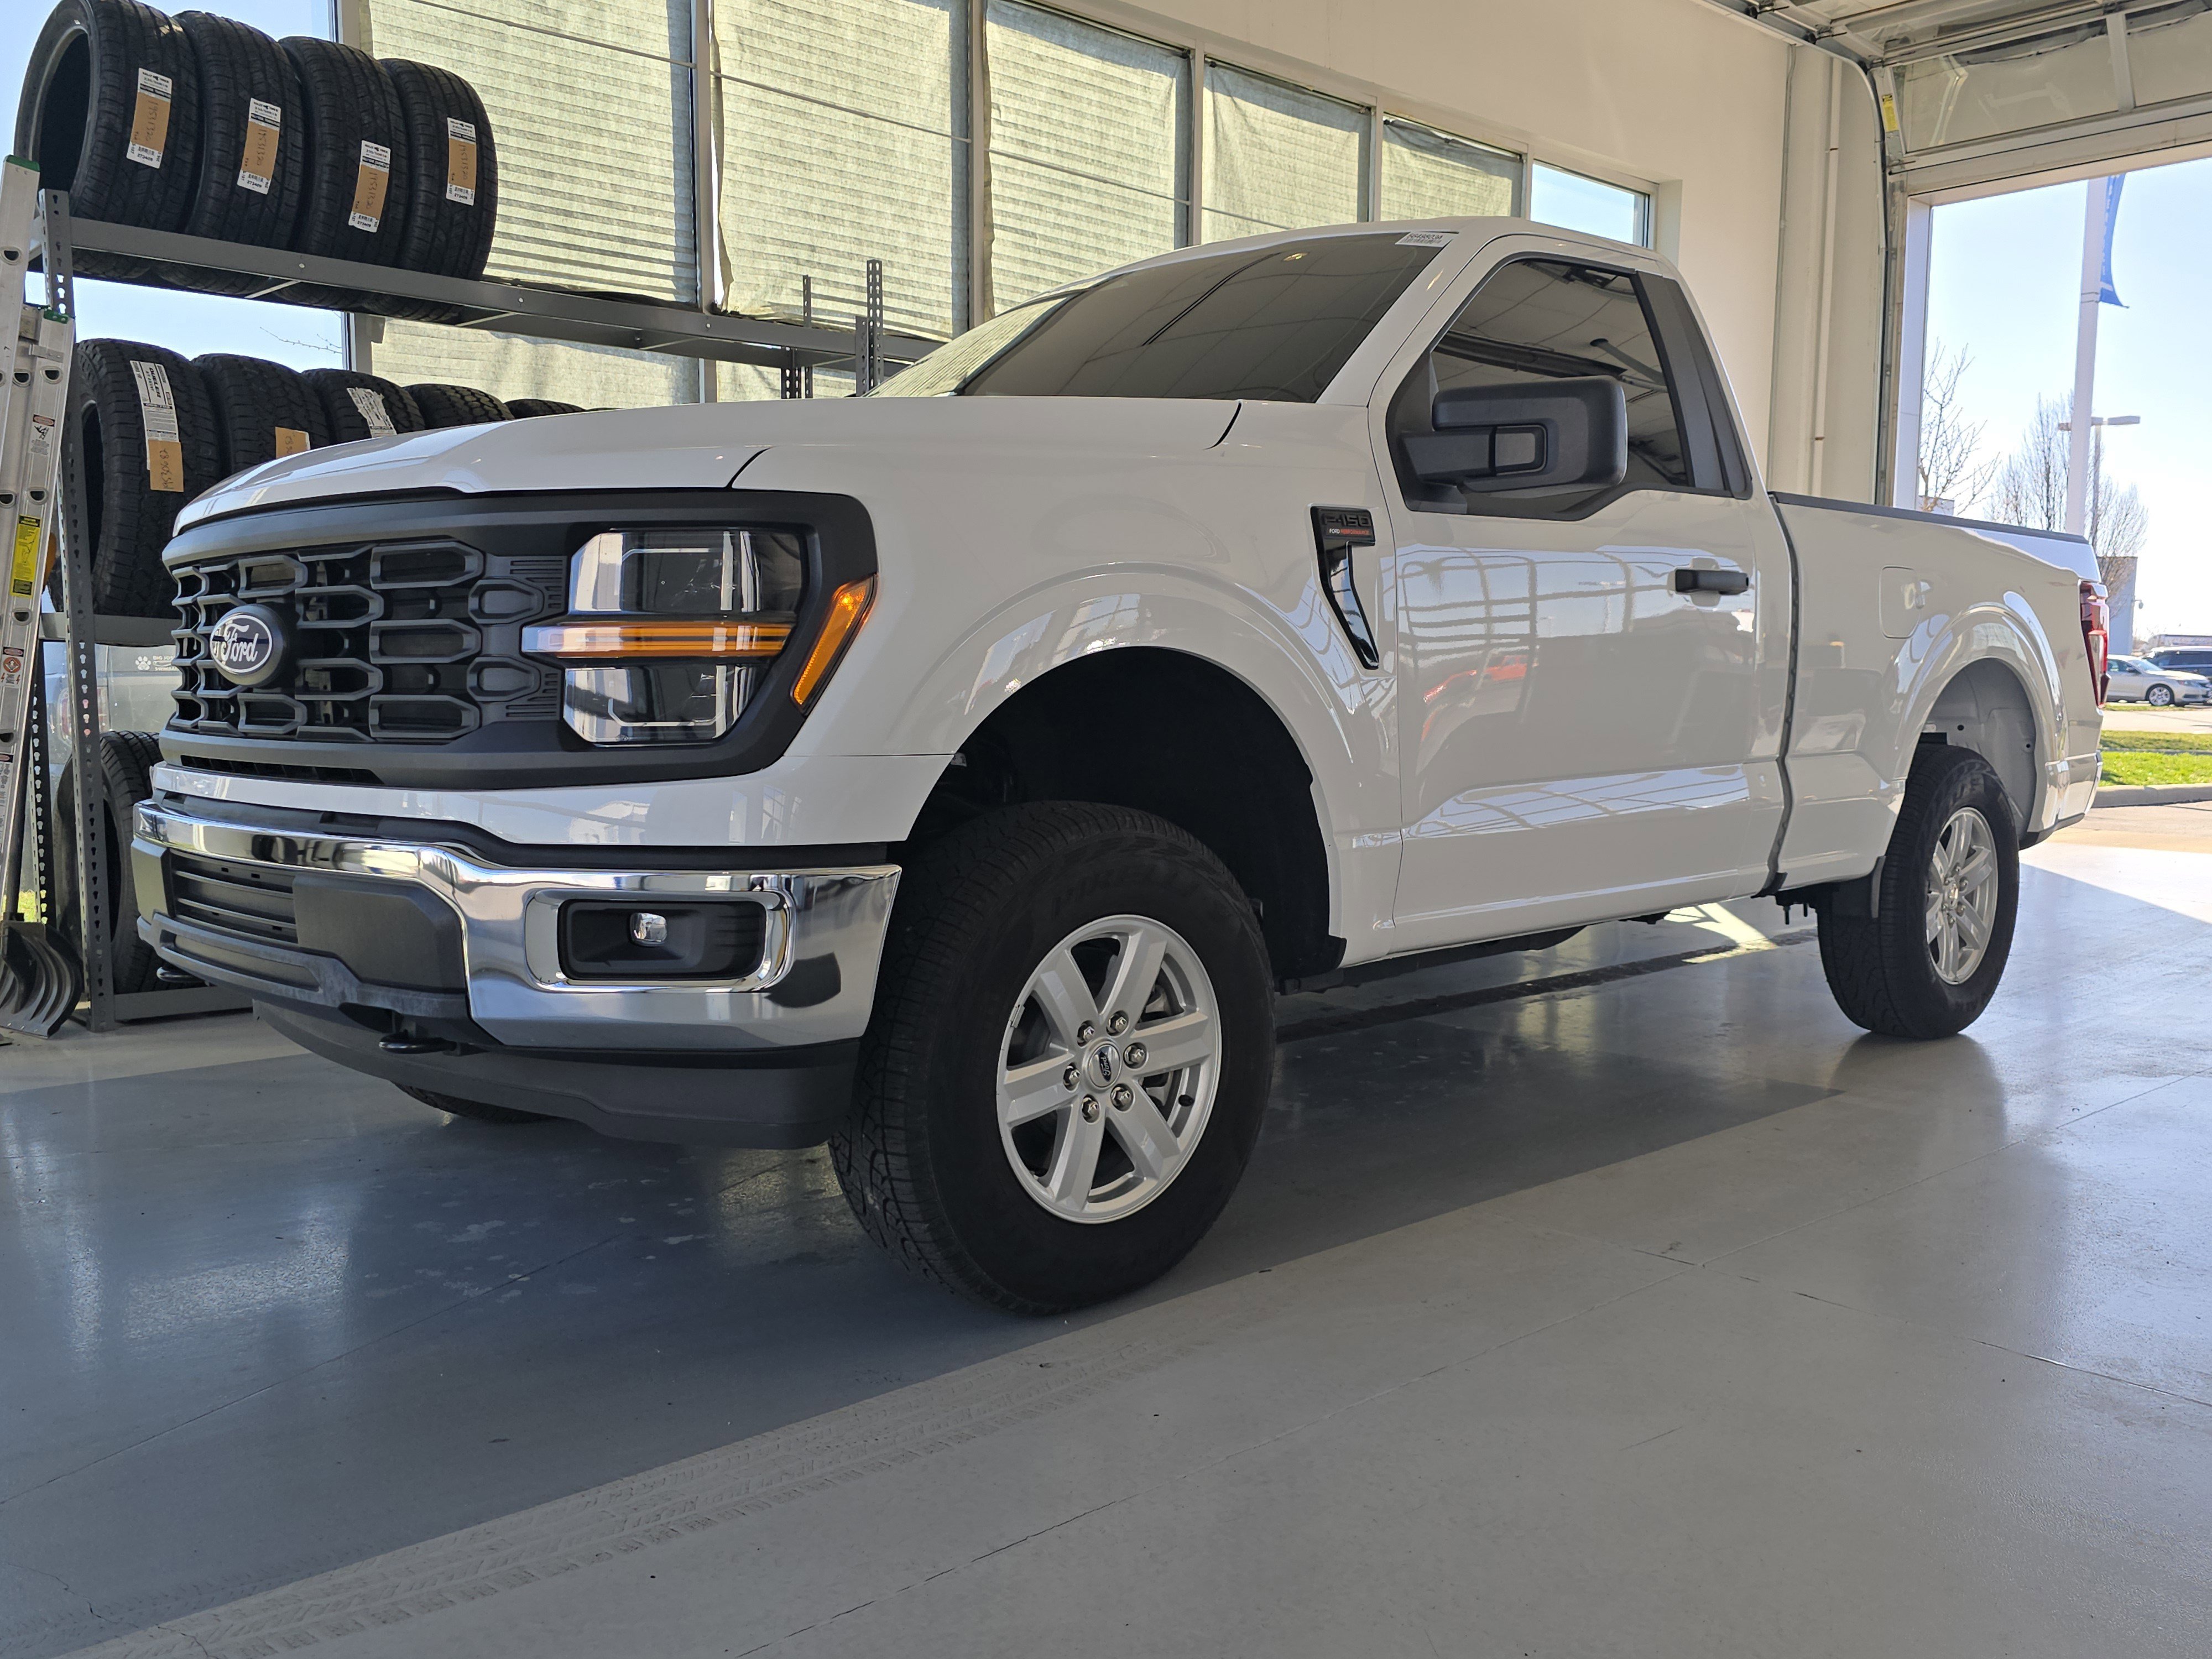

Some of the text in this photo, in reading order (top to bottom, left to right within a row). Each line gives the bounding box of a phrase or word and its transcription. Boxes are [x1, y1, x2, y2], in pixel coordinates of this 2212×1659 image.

[149, 367, 161, 398] DUELER
[1322, 513, 1371, 526] F-150
[221, 623, 258, 661] Ford
[1100, 1055, 1110, 1076] Ford
